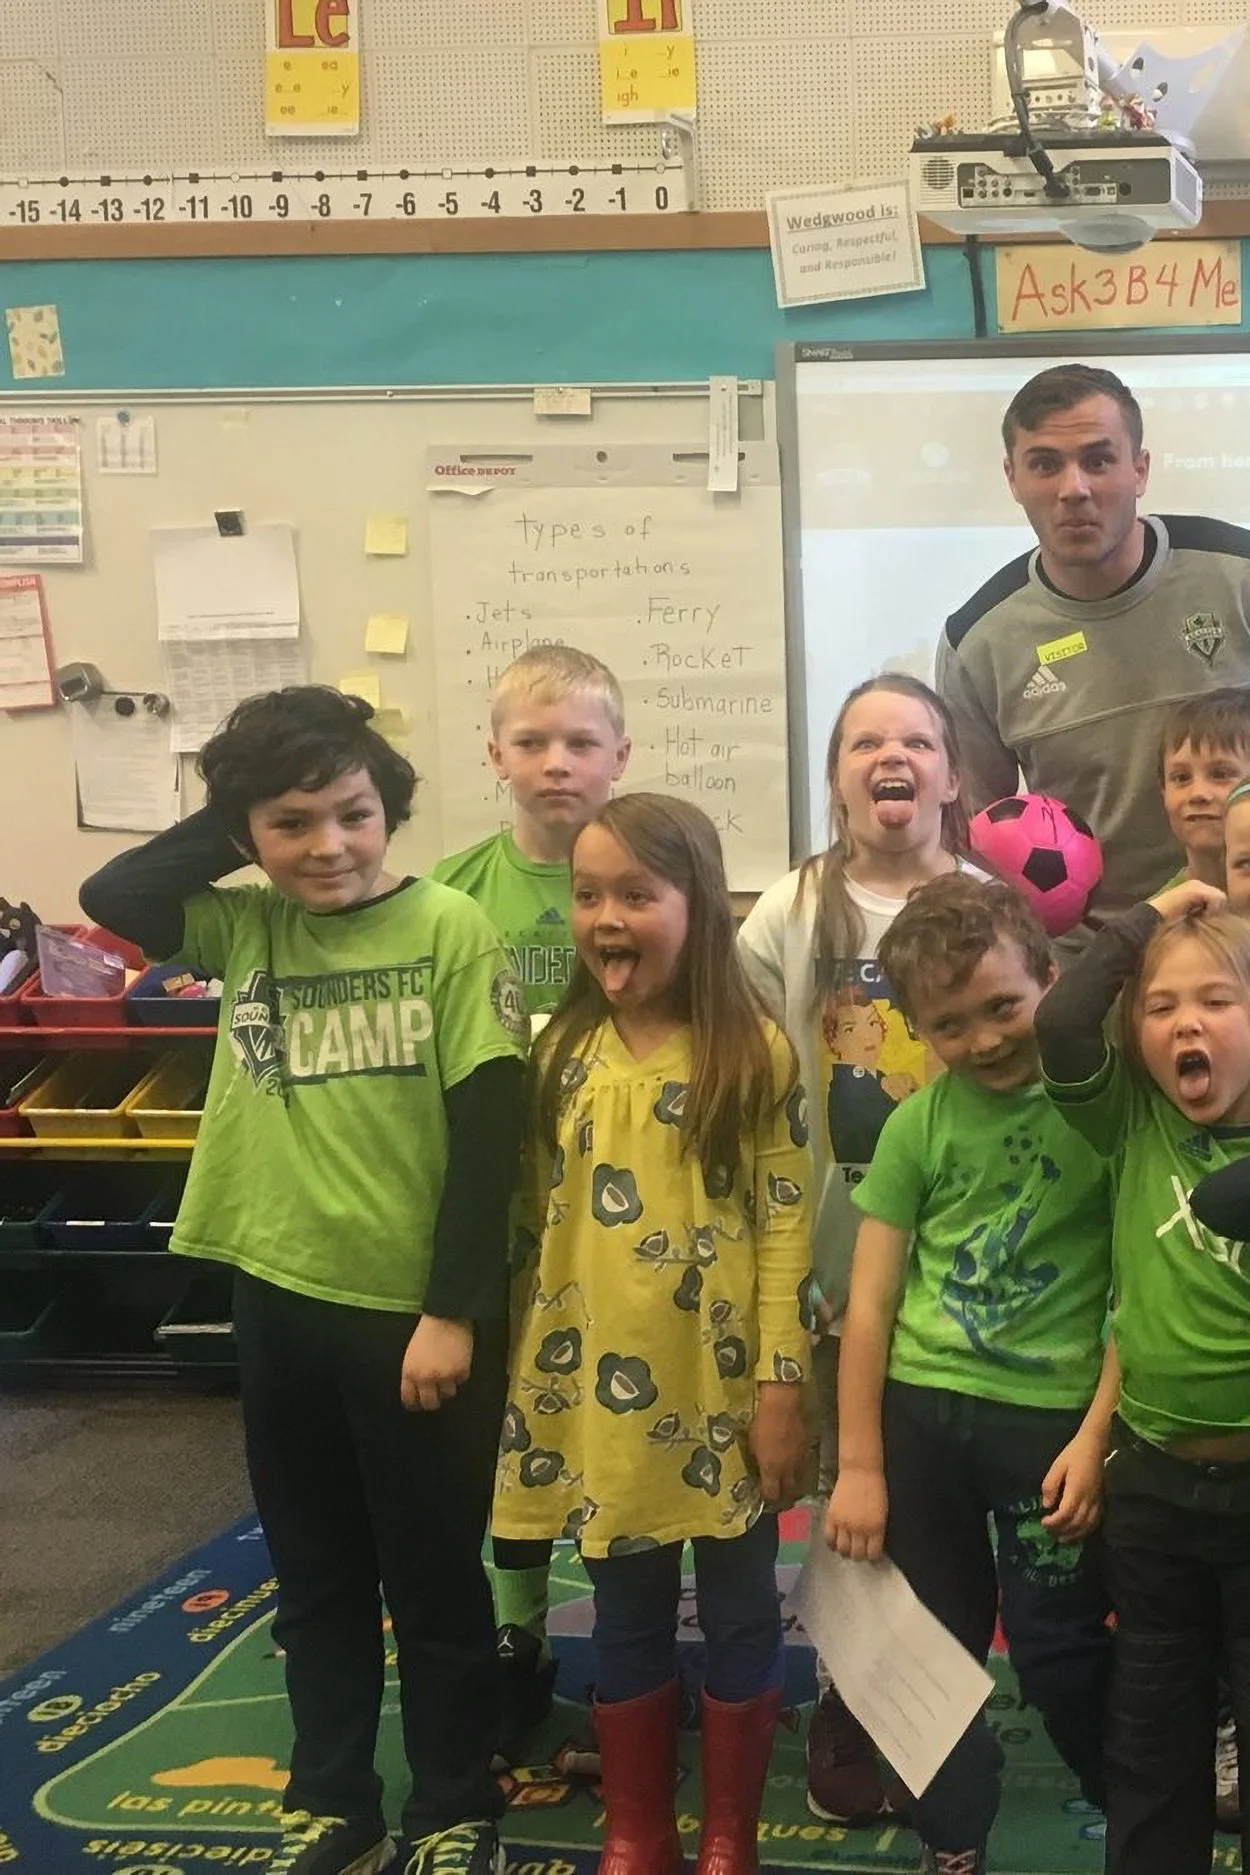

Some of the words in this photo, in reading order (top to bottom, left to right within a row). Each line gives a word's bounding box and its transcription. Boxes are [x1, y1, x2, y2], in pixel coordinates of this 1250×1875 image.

[9, 199, 41, 223] -15
[50, 198, 81, 222] -14
[91, 198, 123, 221] -13
[133, 197, 165, 221] -12
[179, 195, 209, 218] -11
[221, 194, 252, 218] -10
[268, 194, 289, 218] -9
[310, 194, 331, 217] -8
[353, 192, 372, 216] -7
[395, 191, 416, 215] -6
[438, 191, 459, 215] -5
[481, 190, 500, 214] -4
[523, 189, 543, 213] -3
[565, 188, 585, 212] -2
[608, 187, 627, 211] -1
[655, 186, 668, 210] 0
[786, 204, 876, 230] Wedgwood
[1012, 263, 1094, 321] Ask
[1189, 257, 1238, 309] Me
[435, 465, 476, 476] Office
[477, 466, 517, 476] DEPOT
[1163, 453, 1214, 469] From
[514, 511, 606, 551] types
[625, 515, 652, 540] of
[508, 557, 690, 590] transportations
[476, 600, 532, 624] Jets
[648, 597, 720, 633] Ferry
[1044, 642, 1084, 662] VISITOR
[656, 685, 772, 716] Submarine
[1023, 682, 1068, 699] adidas
[666, 724, 704, 758] Hot
[710, 741, 741, 761] air
[665, 761, 736, 793] balloon
[291, 971, 391, 1009] SOUNDERS
[399, 969, 424, 999] FC
[289, 1000, 434, 1078] CAMP
[107, 1569, 213, 1634] nineteen
[36, 1672, 161, 1753] dieciocho
[107, 1791, 174, 1812] las
